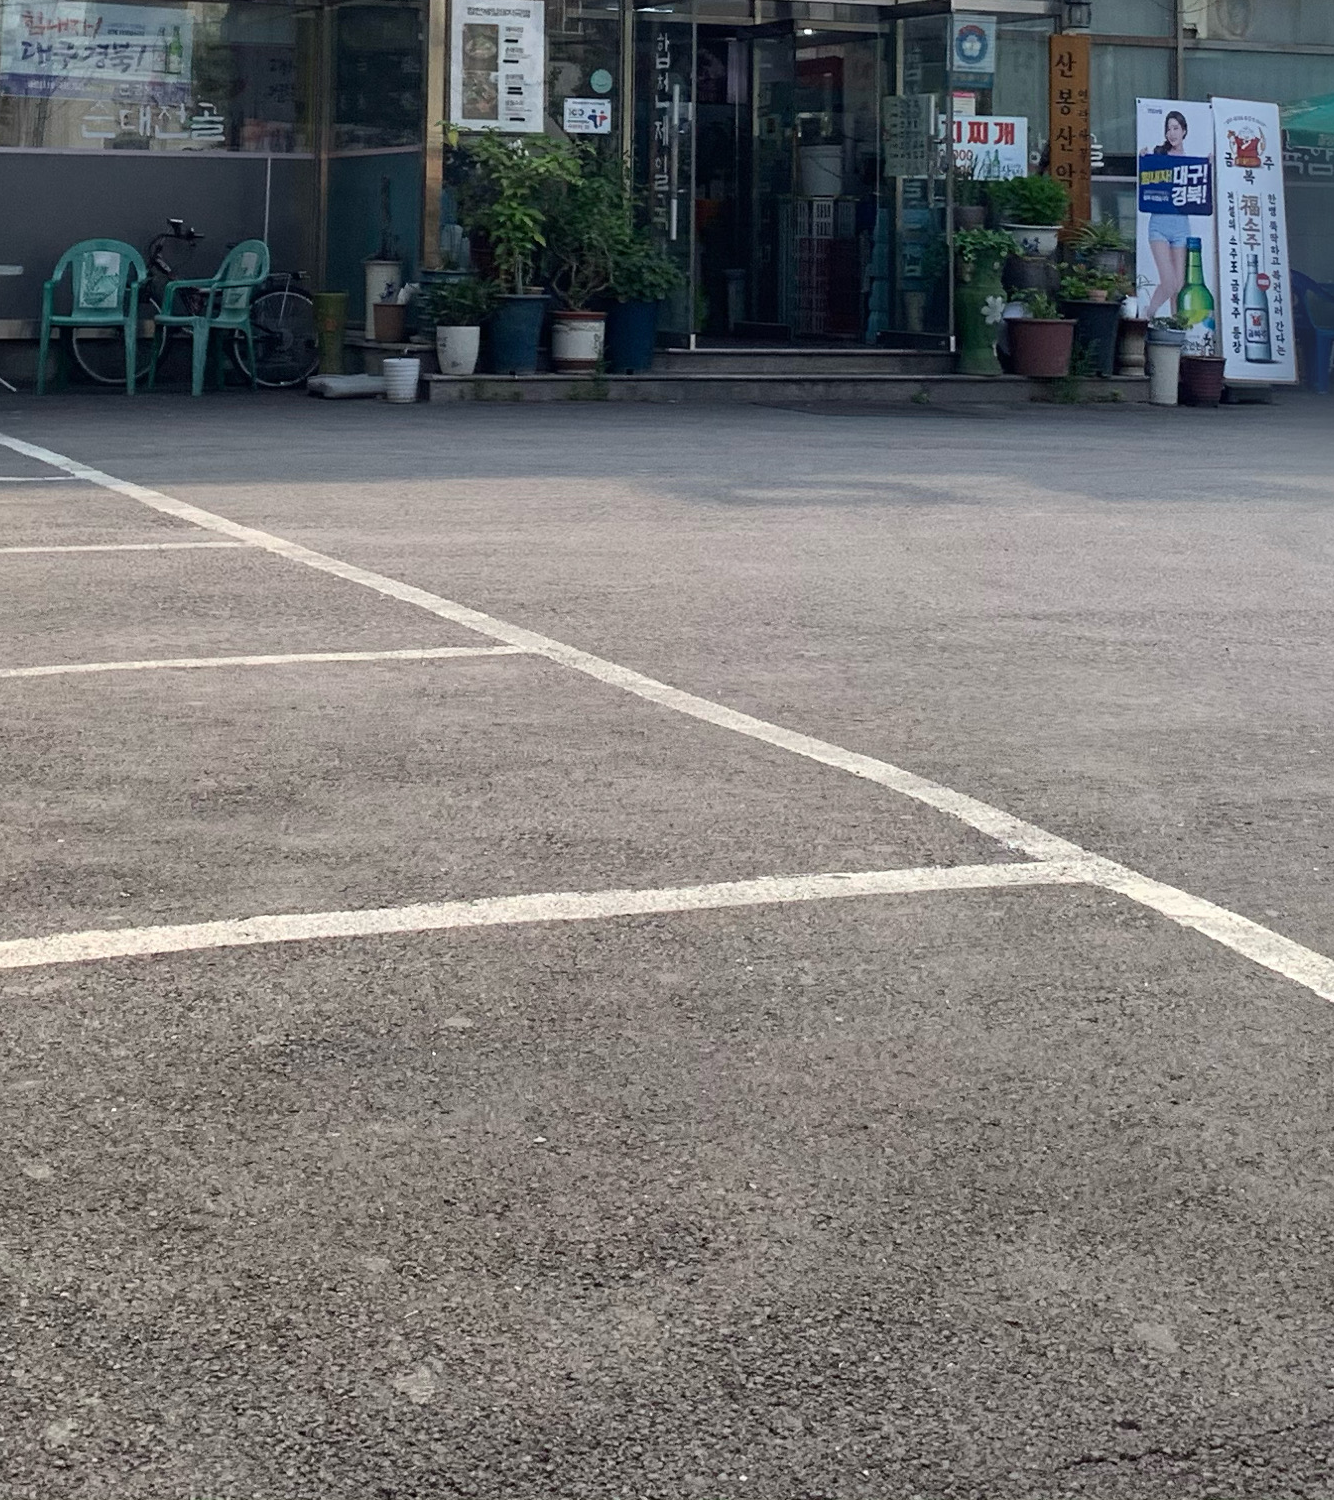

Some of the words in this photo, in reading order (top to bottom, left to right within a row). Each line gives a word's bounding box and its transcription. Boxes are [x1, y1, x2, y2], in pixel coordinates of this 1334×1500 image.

[81, 102, 226, 141] 순대전골
[1055, 52, 1077, 226] 산봉산악
[1173, 164, 1208, 185] 대구!
[1171, 184, 1207, 207] 경북!
